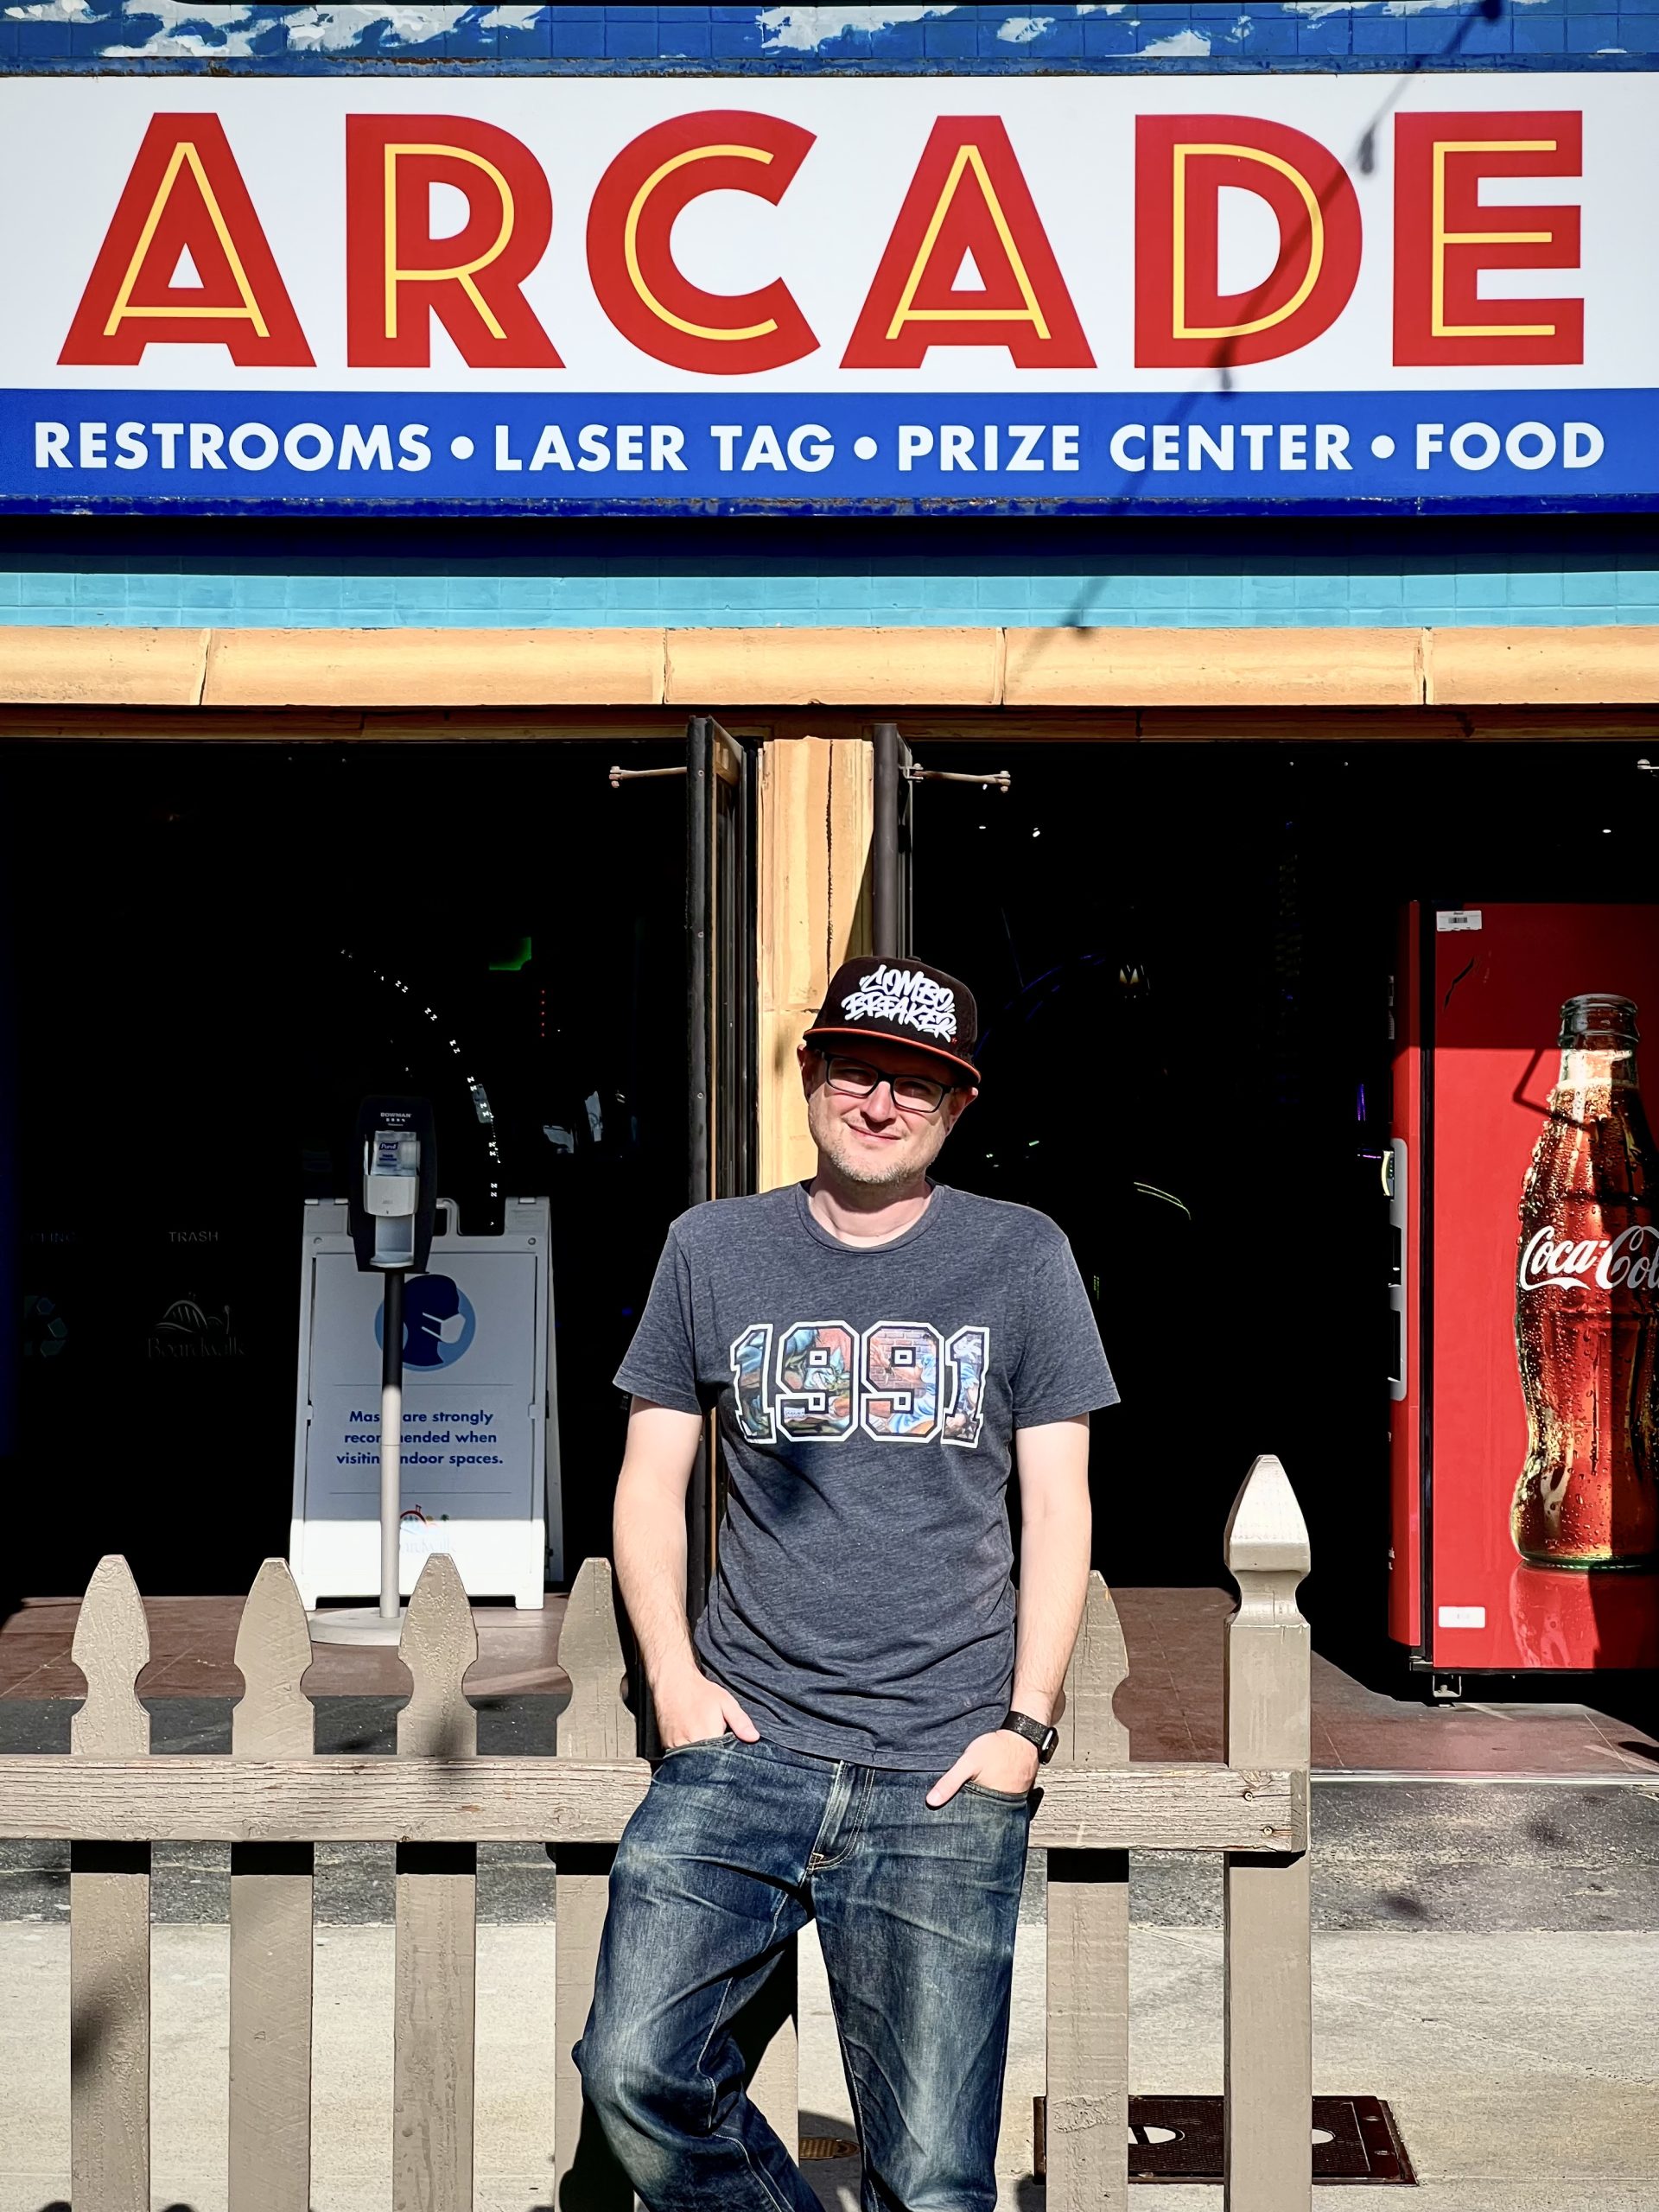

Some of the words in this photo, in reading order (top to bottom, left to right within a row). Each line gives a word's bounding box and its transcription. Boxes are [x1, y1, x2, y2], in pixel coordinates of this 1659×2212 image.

[57, 109, 1585, 375] ARCADE
[35, 422, 432, 472] RESTROOMS
[495, 423, 689, 472] LASER
[710, 423, 836, 473] TAG
[898, 423, 1080, 472] PRIZE
[1109, 423, 1352, 472] CENTER
[1415, 420, 1605, 470] FOOD
[859, 964, 956, 1013] COMBO
[841, 992, 957, 1043] BREAKER
[168, 1230, 219, 1243] TRASH
[1519, 1225, 1659, 1291] Coca-Col
[730, 1319, 990, 1449] 1991
[344, 1431, 450, 1443] recoended
[455, 1431, 497, 1443] when
[349, 1410, 380, 1422] Mas
[403, 1413, 427, 1422] are
[432, 1409, 493, 1425] strongly
[336, 1452, 380, 1465] visitin
[401, 1452, 445, 1465] ndoor
[449, 1454, 504, 1467] spaces.
